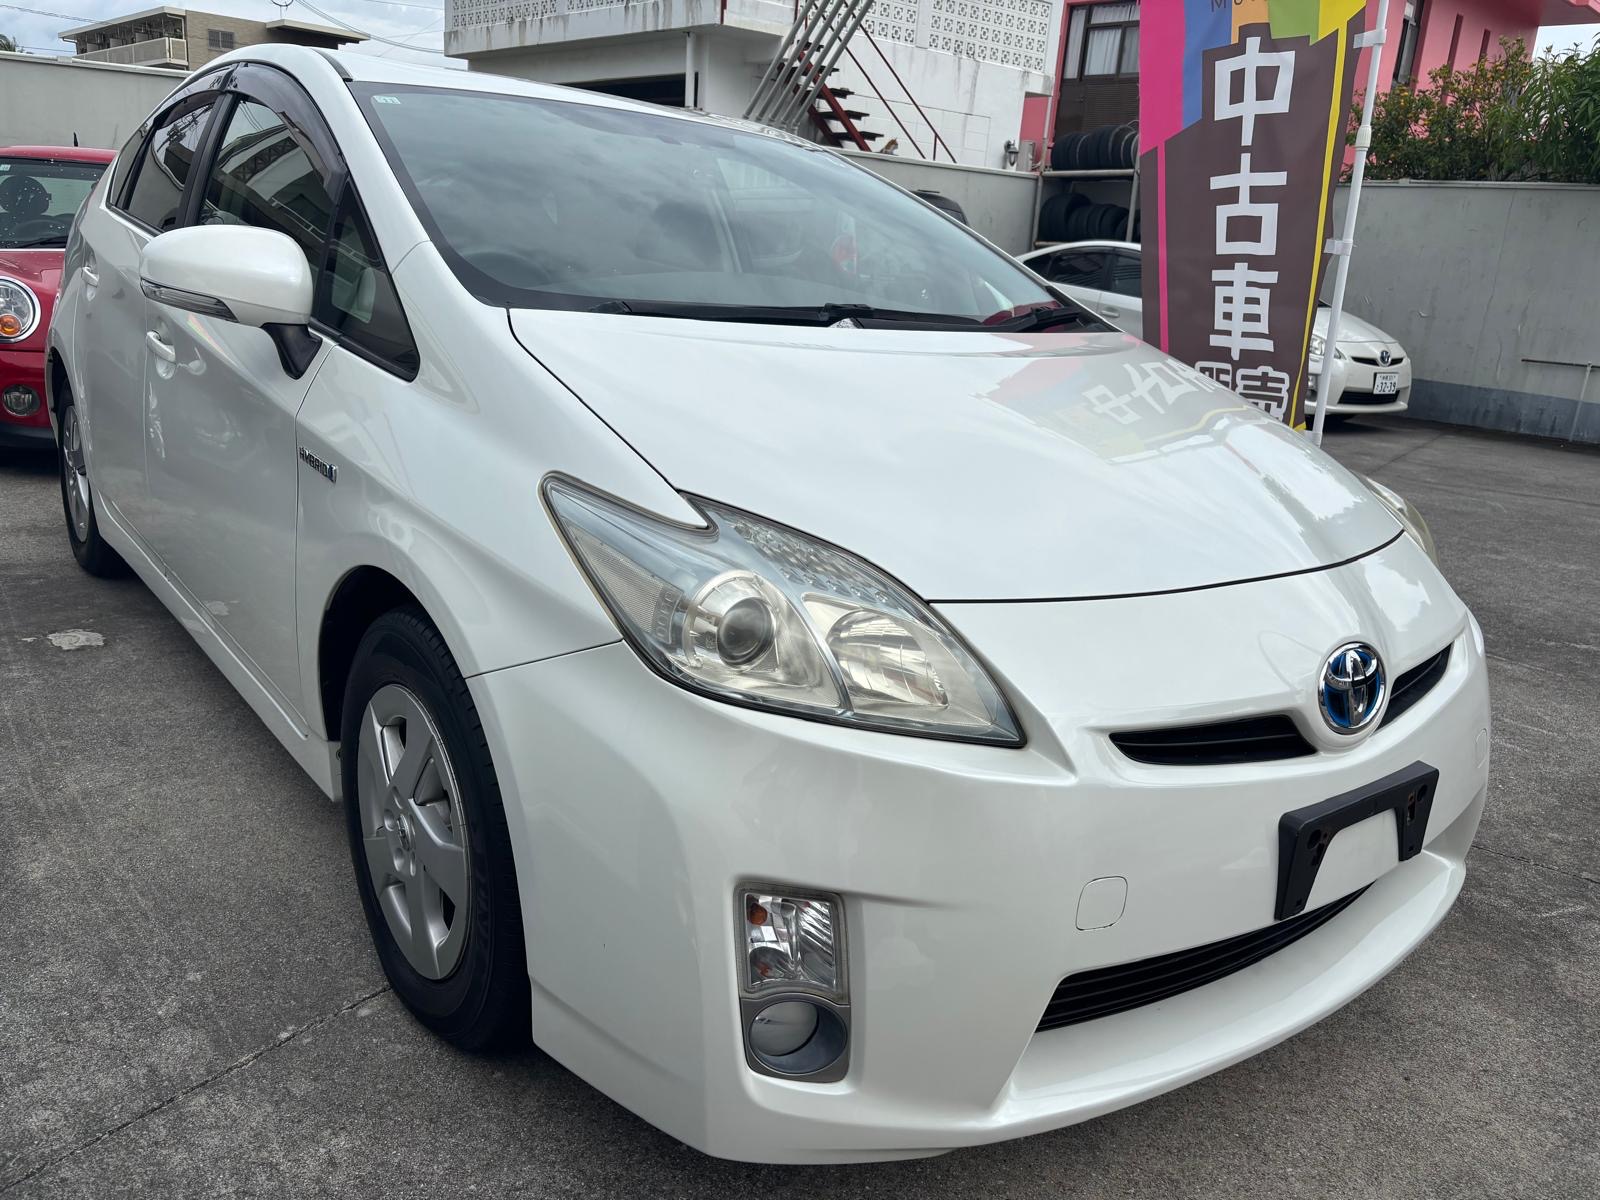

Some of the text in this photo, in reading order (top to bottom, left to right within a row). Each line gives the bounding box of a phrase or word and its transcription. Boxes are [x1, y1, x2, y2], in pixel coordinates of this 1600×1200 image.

[1209, 36, 1296, 361] 中古車
[299, 446, 328, 478] HYBRID
